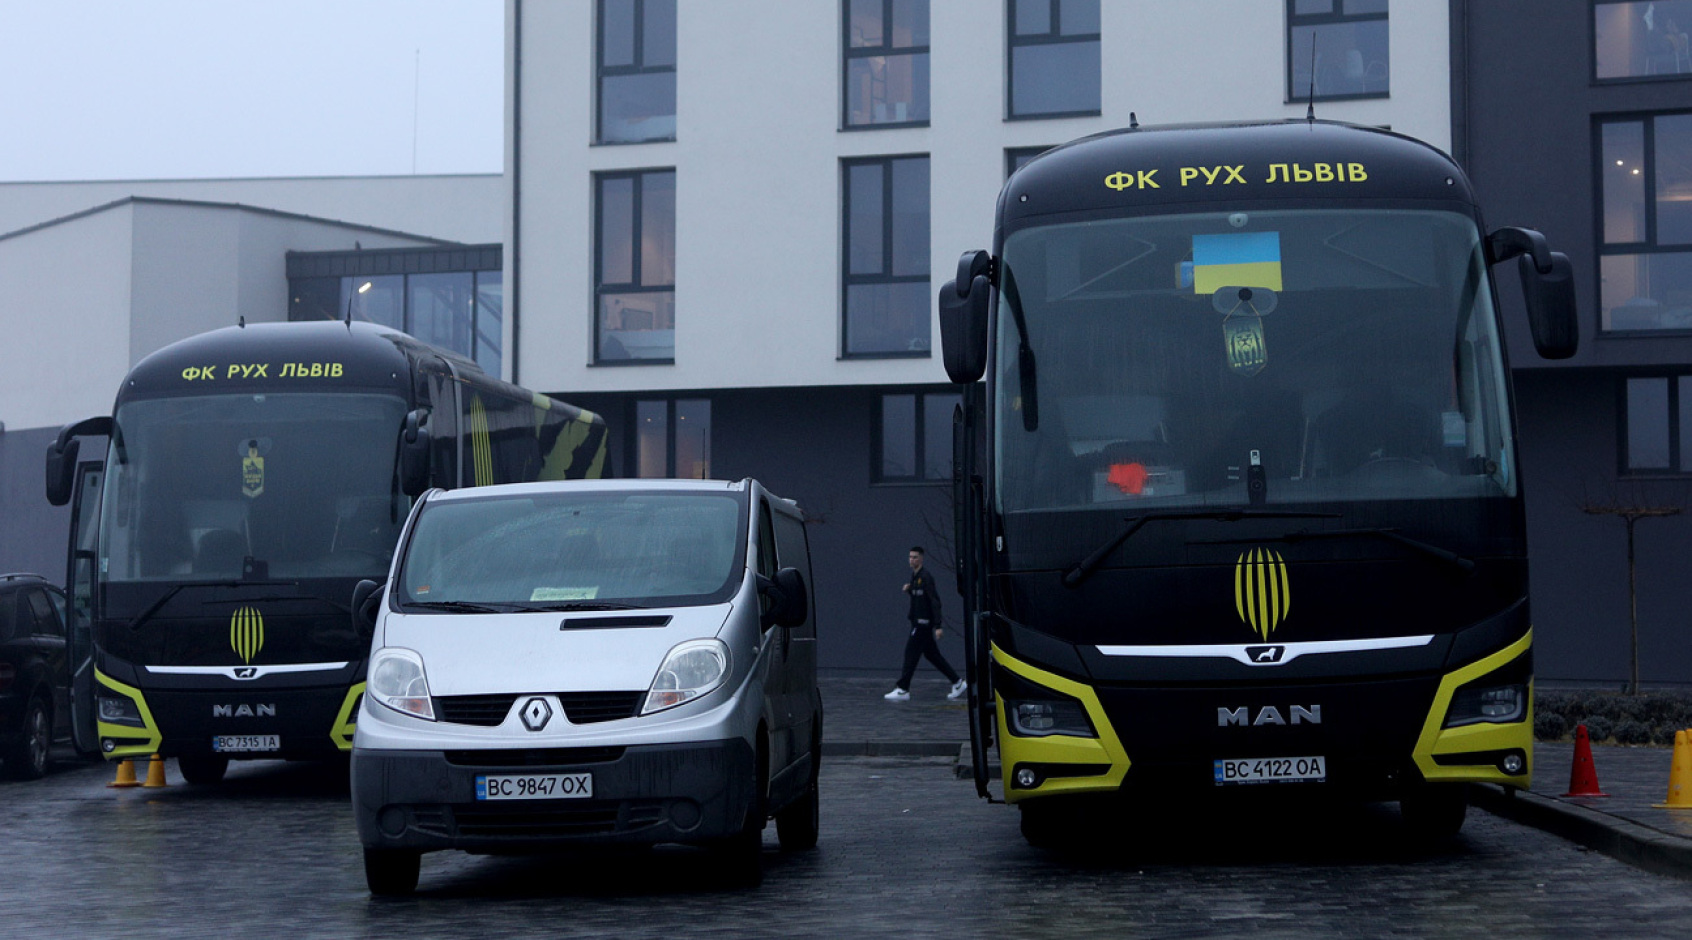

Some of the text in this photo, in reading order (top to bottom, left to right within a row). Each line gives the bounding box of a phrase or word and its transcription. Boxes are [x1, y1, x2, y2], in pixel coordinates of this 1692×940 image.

[1104, 162, 1368, 191] ФК РУХ ЛЬВІВ
[181, 362, 344, 381] ФК РУХ ЛЬВІВ
[213, 704, 277, 718] MAN
[1217, 704, 1322, 726] MAN
[1225, 761, 1249, 778] BC
[1253, 760, 1292, 777] 4122
[488, 778, 513, 796] BC
[517, 777, 557, 795] 9847
